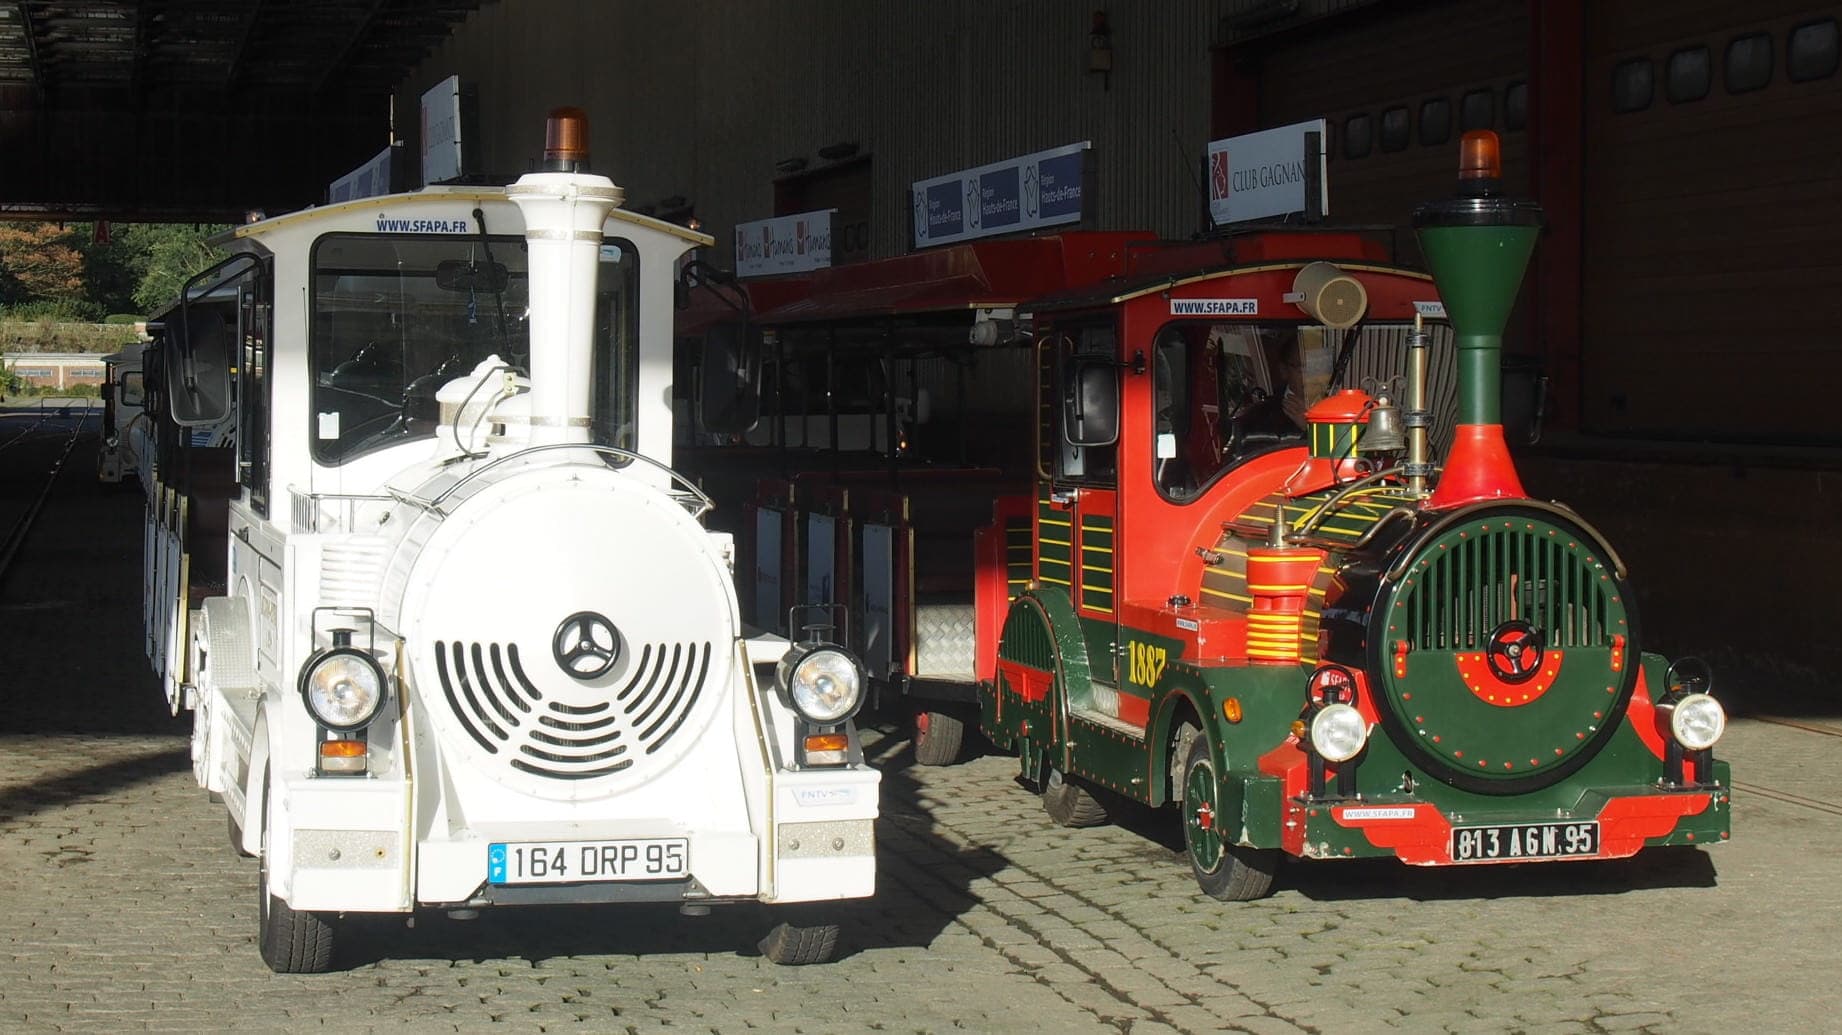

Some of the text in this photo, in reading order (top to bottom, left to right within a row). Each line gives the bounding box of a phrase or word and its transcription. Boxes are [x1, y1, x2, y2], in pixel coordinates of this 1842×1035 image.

[1233, 168, 1258, 192] CLUB
[1041, 185, 1081, 204] Hauts-de-France
[982, 198, 1018, 216] Hauts-de-France
[377, 220, 467, 233] WWW.SFAPA.FR
[1173, 302, 1255, 314] WWW.SFAPA.FR
[1129, 640, 1166, 688] 1887
[1344, 809, 1413, 818] WWW.SFAPA.FR
[1458, 829, 1500, 859] 813
[1566, 824, 1592, 853] 95
[494, 844, 683, 877] F 164 DRP 95
